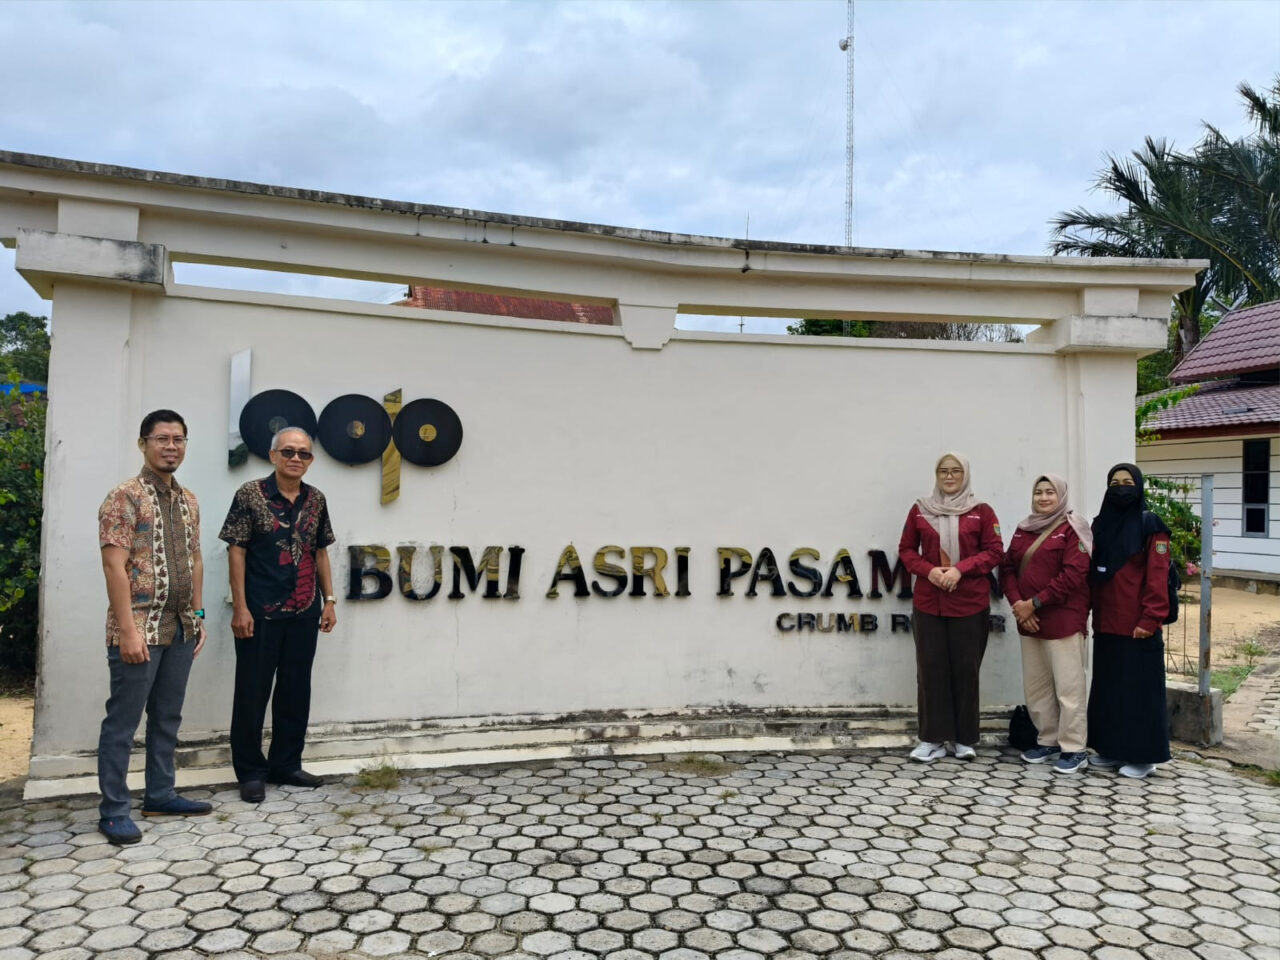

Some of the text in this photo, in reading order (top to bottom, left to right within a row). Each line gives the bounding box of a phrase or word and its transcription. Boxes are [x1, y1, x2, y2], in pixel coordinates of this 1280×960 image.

[345, 543, 1004, 600] BUMI ASRI PASAM
[776, 612, 878, 633] CRUMB
